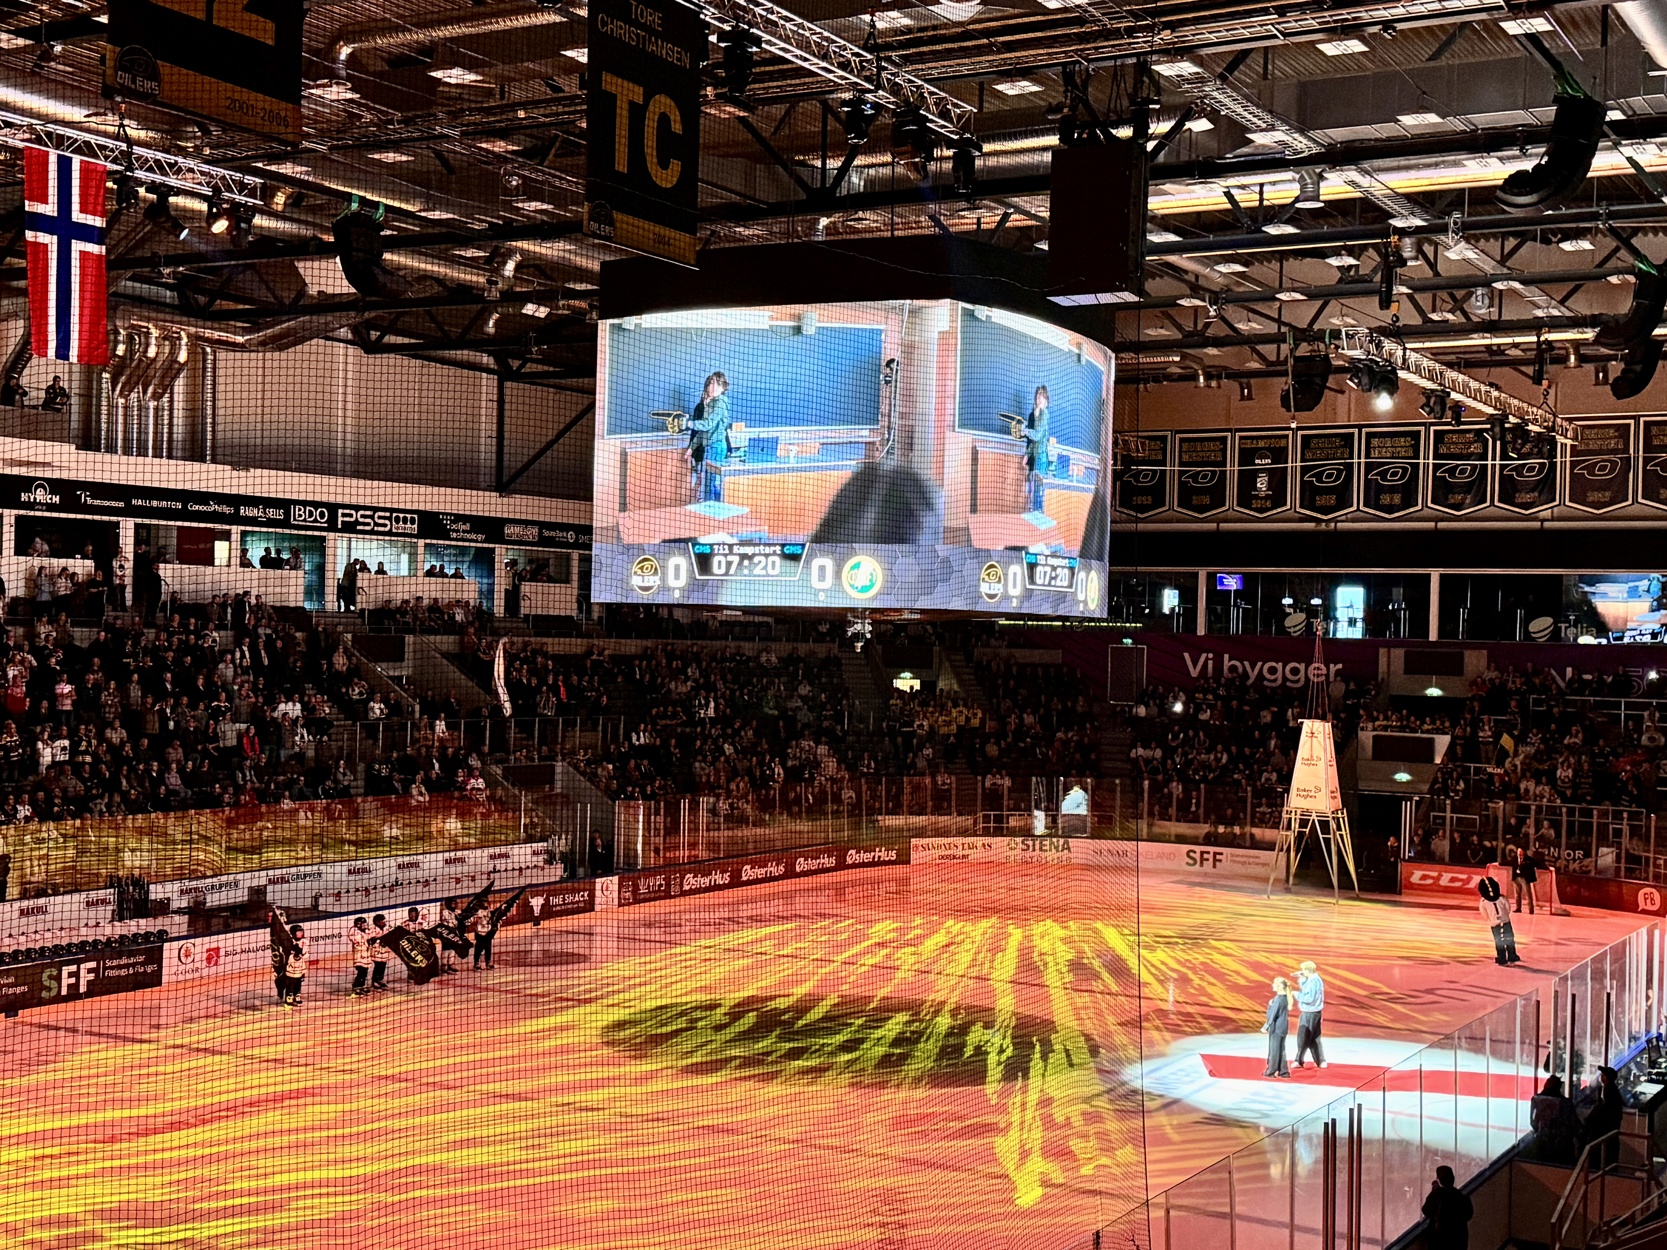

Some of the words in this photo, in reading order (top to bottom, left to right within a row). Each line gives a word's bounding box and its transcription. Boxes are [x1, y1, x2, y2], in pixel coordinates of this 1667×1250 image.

[629, 0, 663, 31] TORE
[597, 13, 690, 69] CHRISTIANSEN
[116, 70, 160, 95] OILERS
[226, 96, 290, 129] 2001-2006
[602, 70, 682, 189] TC
[589, 221, 615, 237] OILERS
[131, 498, 182, 509] HALLIBURTON
[295, 505, 329, 523] BDO
[337, 508, 391, 532] PSS
[668, 556, 687, 588] 0
[712, 555, 781, 576] 07:20
[811, 557, 834, 590] 0
[1035, 565, 1069, 587] 07:20
[1008, 564, 1022, 597] 0
[1184, 651, 1214, 678] Vi
[1223, 653, 1343, 687] bygger
[846, 847, 898, 864] ØsterHus
[1020, 839, 1072, 853] STENA
[741, 859, 786, 881] ØsterHus
[795, 854, 837, 873] ØsterHus
[1185, 849, 1224, 869] SFF
[682, 867, 731, 891] ØsterHus
[549, 896, 564, 906] THE
[564, 891, 589, 904] SHACK
[399, 939, 428, 968] OILERS
[40, 961, 97, 999] SFF
[104, 966, 128, 977] Fittings
[2, 984, 28, 996] Flanges
